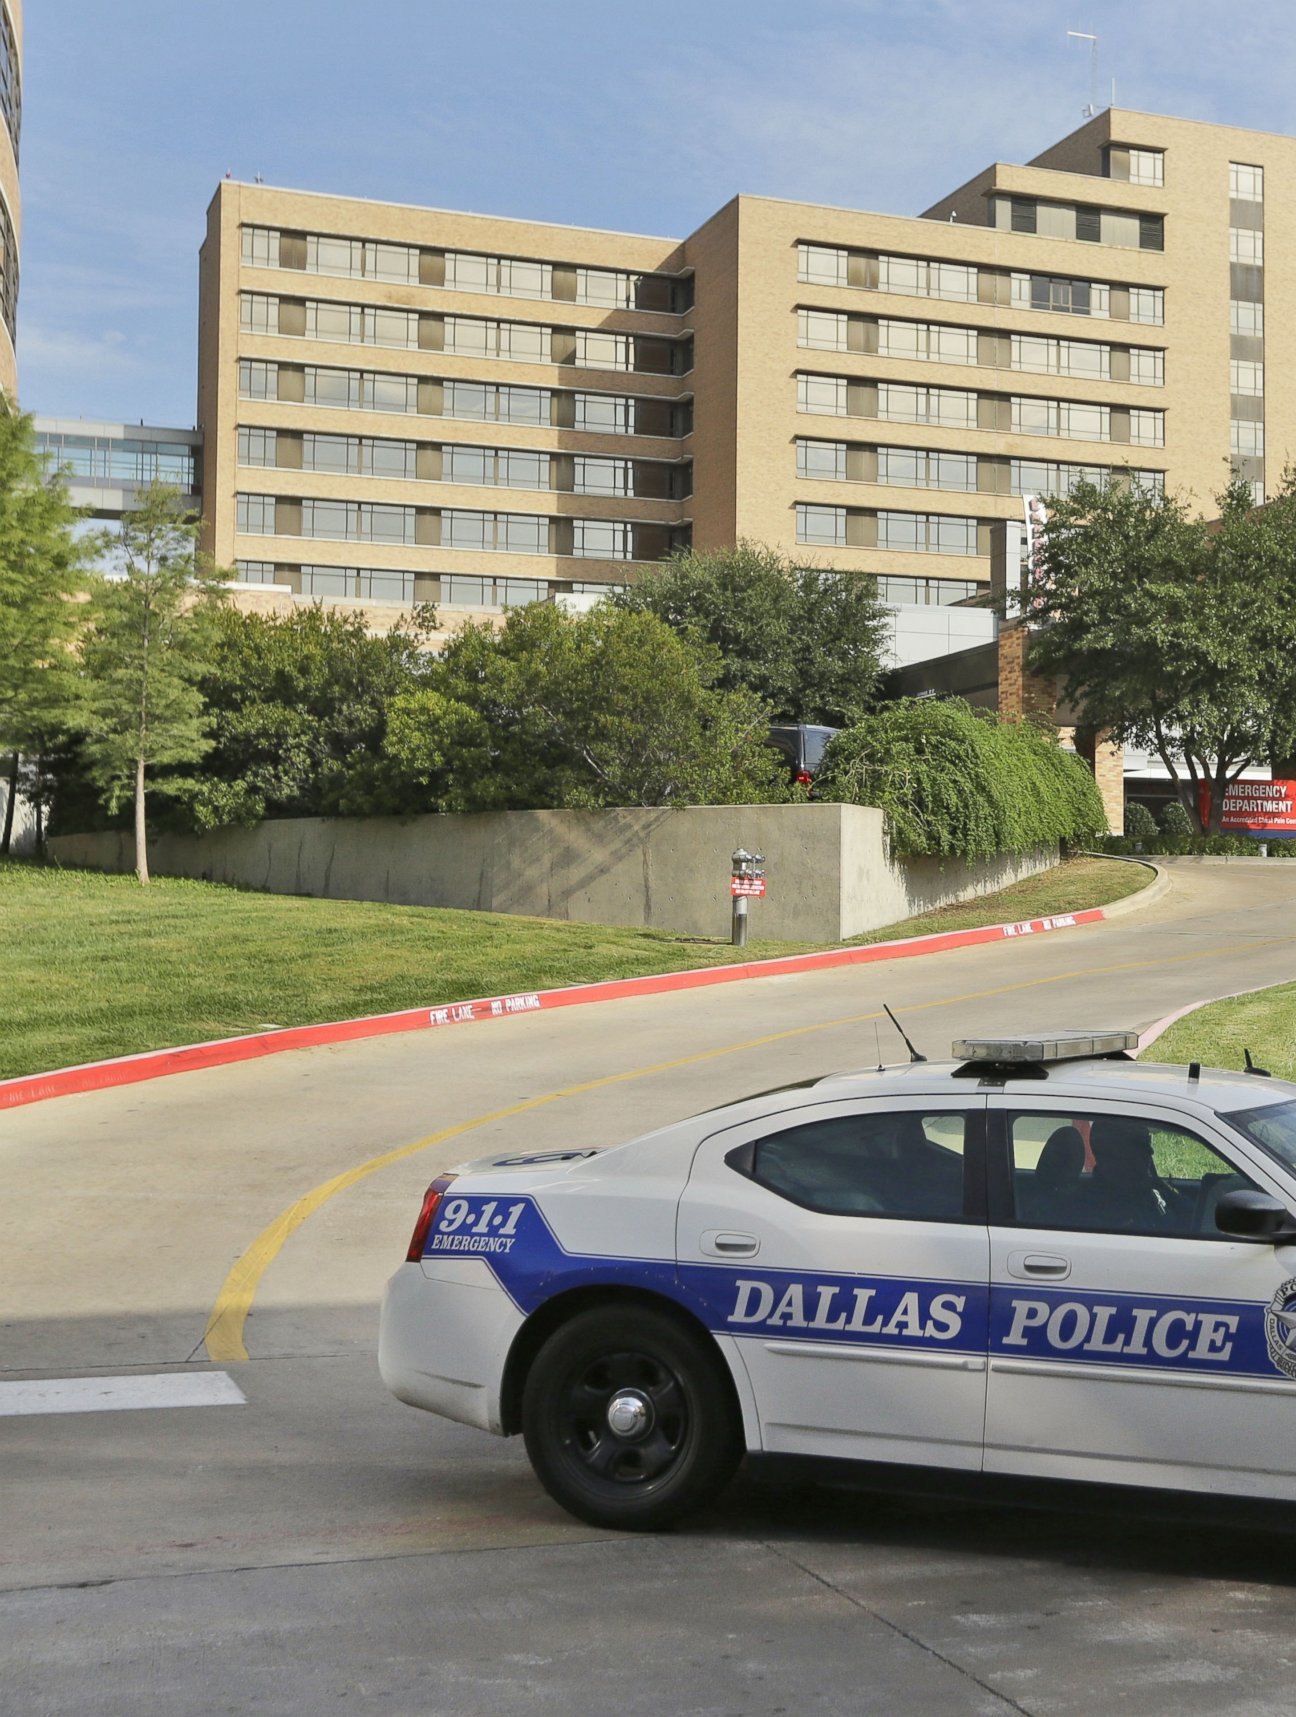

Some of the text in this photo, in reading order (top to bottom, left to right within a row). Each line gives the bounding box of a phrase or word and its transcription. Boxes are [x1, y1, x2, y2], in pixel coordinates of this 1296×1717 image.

[1222, 799, 1293, 813] DEPARTMENT
[430, 994, 540, 1025] FIRE LANE NO PARKING
[431, 1234, 515, 1253] EMERGENCY
[727, 1279, 1239, 1361] DALLAS POLICE
[1269, 1318, 1285, 1351] DALLAS
